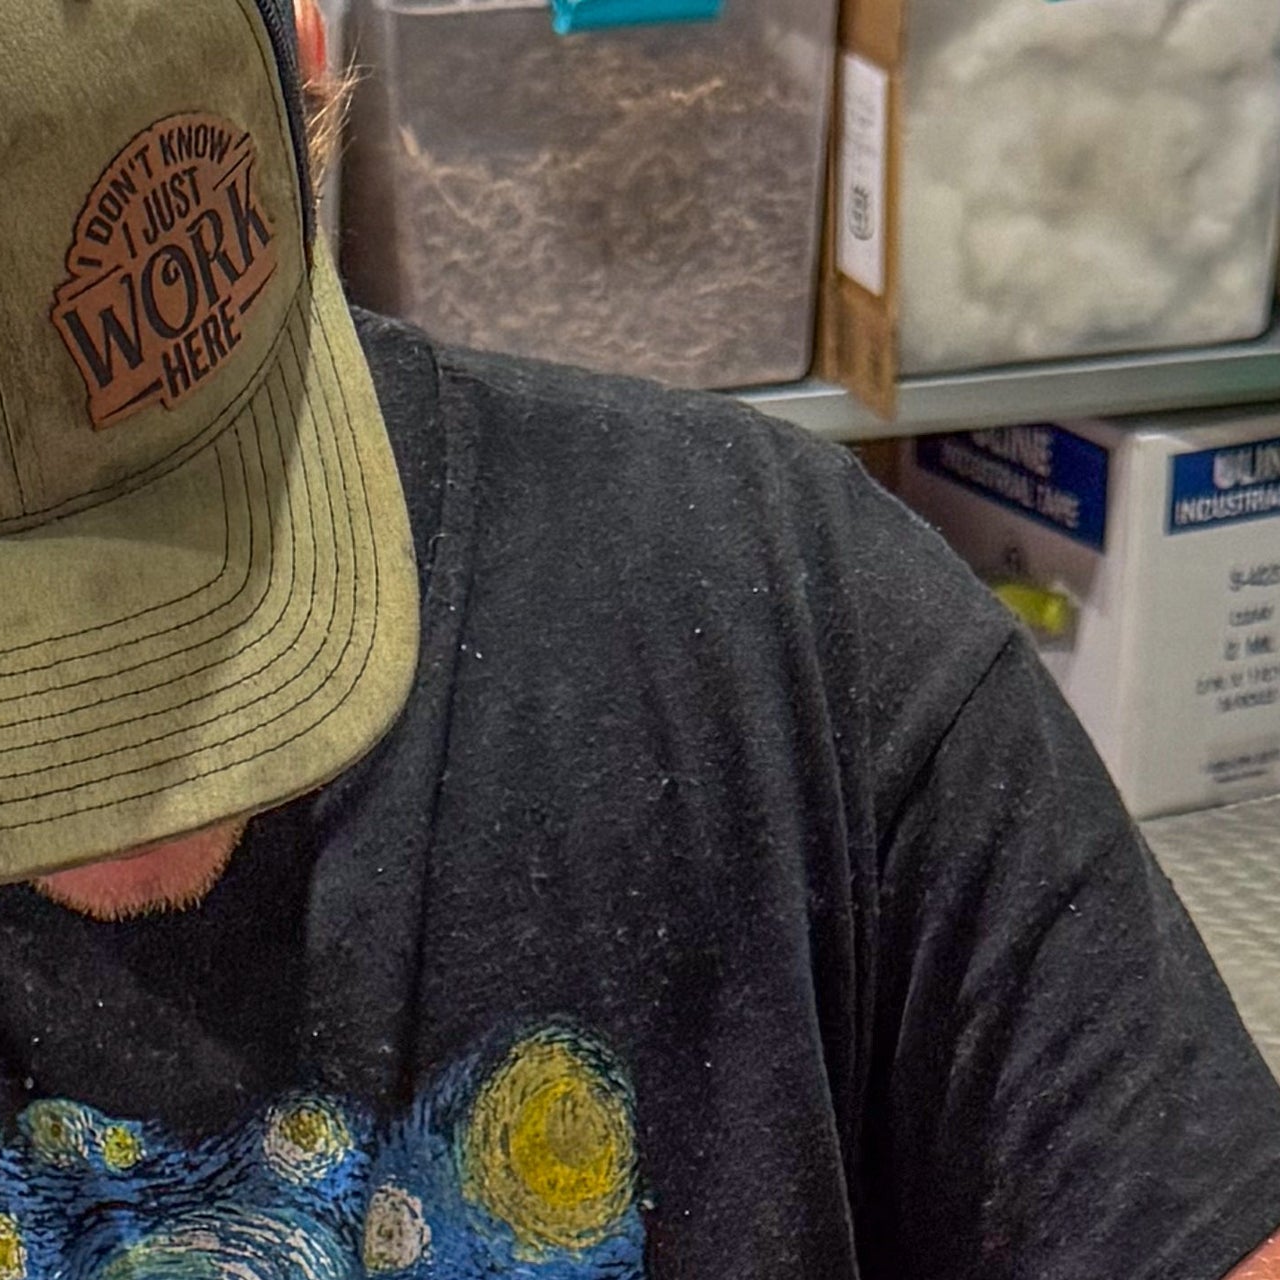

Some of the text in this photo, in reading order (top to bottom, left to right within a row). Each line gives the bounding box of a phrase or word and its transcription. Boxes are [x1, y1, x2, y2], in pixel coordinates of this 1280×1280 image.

[77, 123, 233, 269] I DON'T KNOW
[122, 166, 201, 259] I JUST
[63, 157, 272, 389] WORK
[161, 295, 242, 398] HERE
